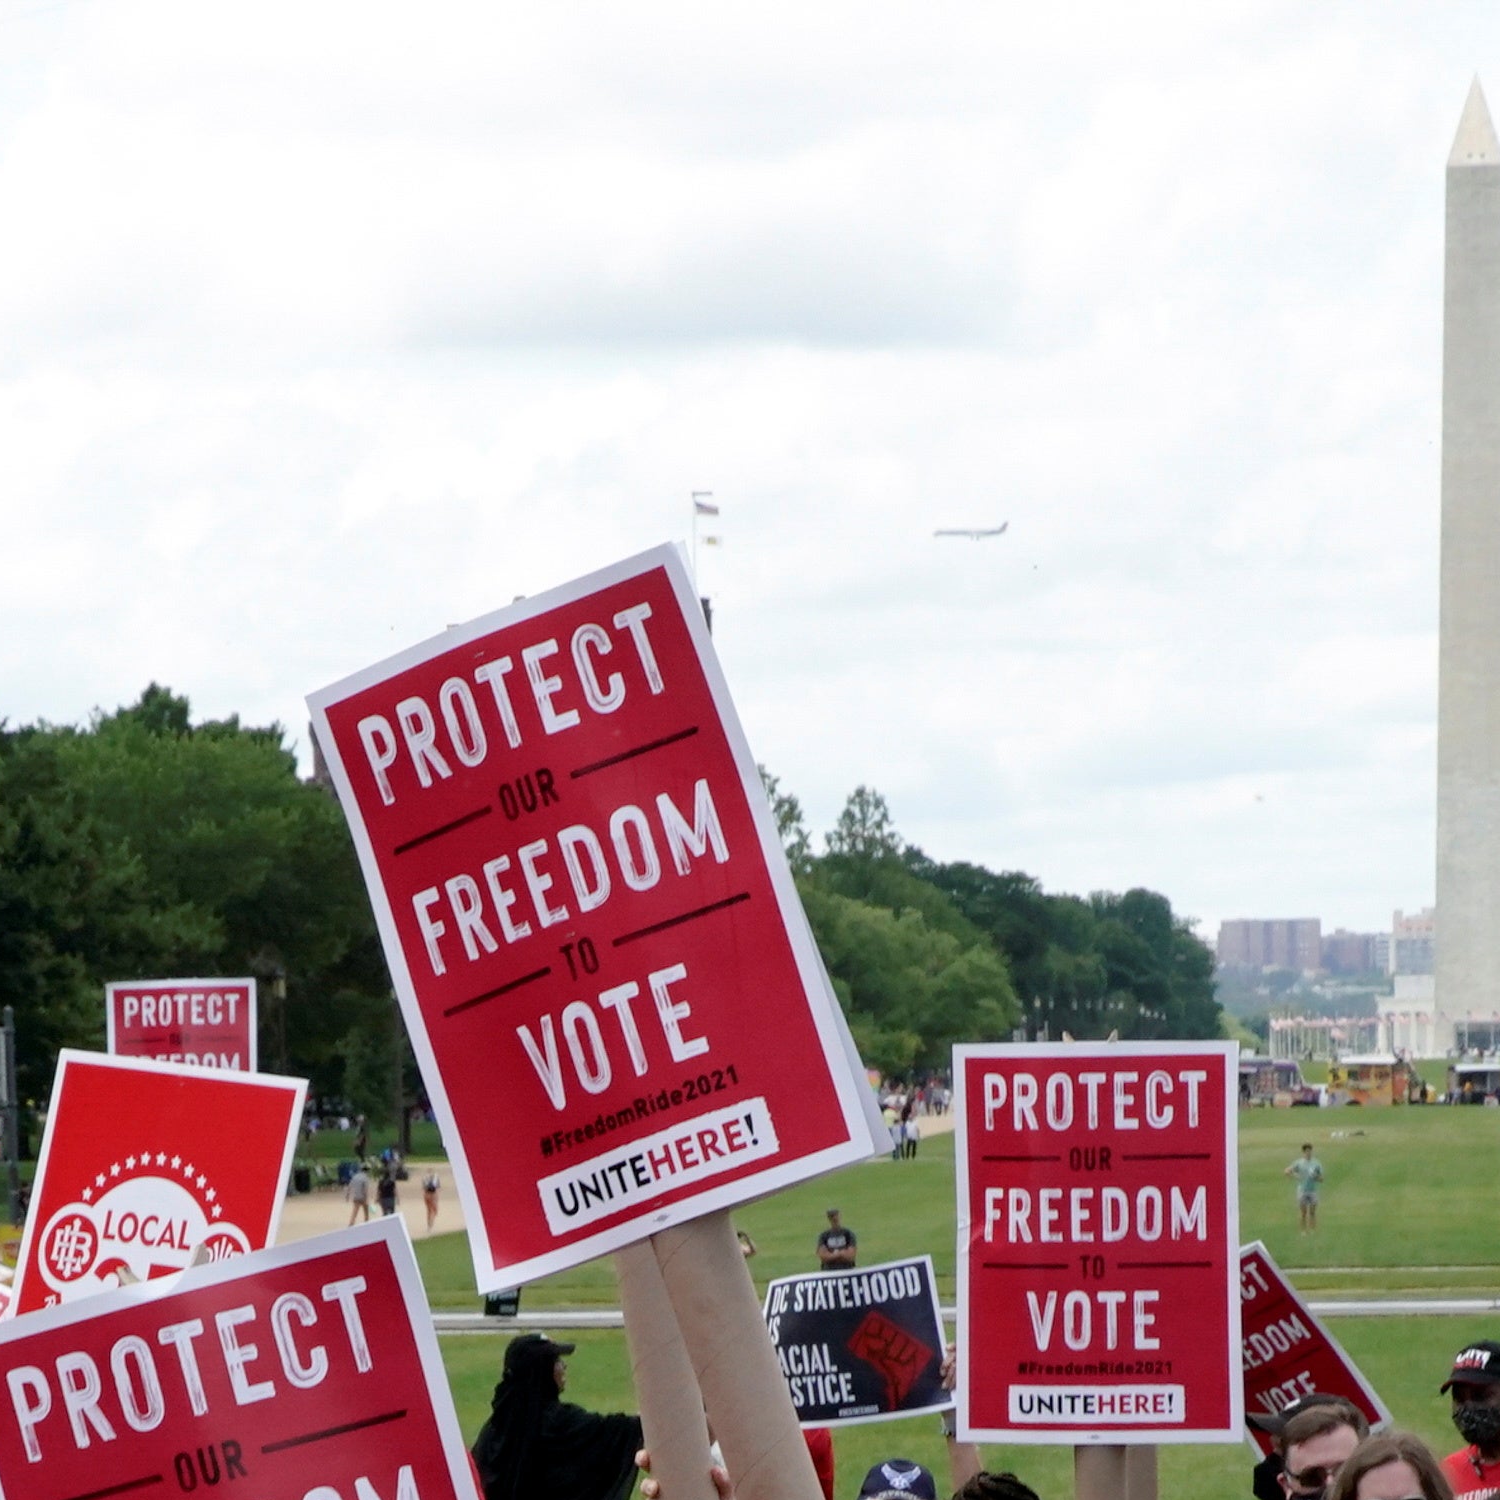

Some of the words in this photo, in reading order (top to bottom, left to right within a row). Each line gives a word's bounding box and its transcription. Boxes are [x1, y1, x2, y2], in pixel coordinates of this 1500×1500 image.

[356, 601, 666, 806] PROTECT
[498, 767, 561, 821] OUR
[412, 778, 730, 976] FREEDOM
[559, 938, 599, 982] TO
[124, 993, 241, 1028] PROTECT
[516, 962, 710, 1111] VOTE
[539, 1064, 740, 1158] #FreedomRide2021
[983, 1069, 1207, 1131] PROTECT
[554, 1114, 760, 1217] UNITEHERE!
[1069, 1146, 1112, 1172] OUR
[103, 1209, 191, 1251] LOCAL
[984, 1185, 1208, 1243] FREEDOM
[771, 1284, 790, 1314] DC
[794, 1265, 921, 1313] STATEHOOD
[1079, 1255, 1105, 1280] TO
[1026, 1290, 1161, 1352] VOTE
[5, 1275, 374, 1465] PROTECT
[1018, 1360, 1172, 1376] #FreedomRide2021
[1018, 1394, 1174, 1415] UNITEHERE!
[173, 1439, 248, 1493] OUR
